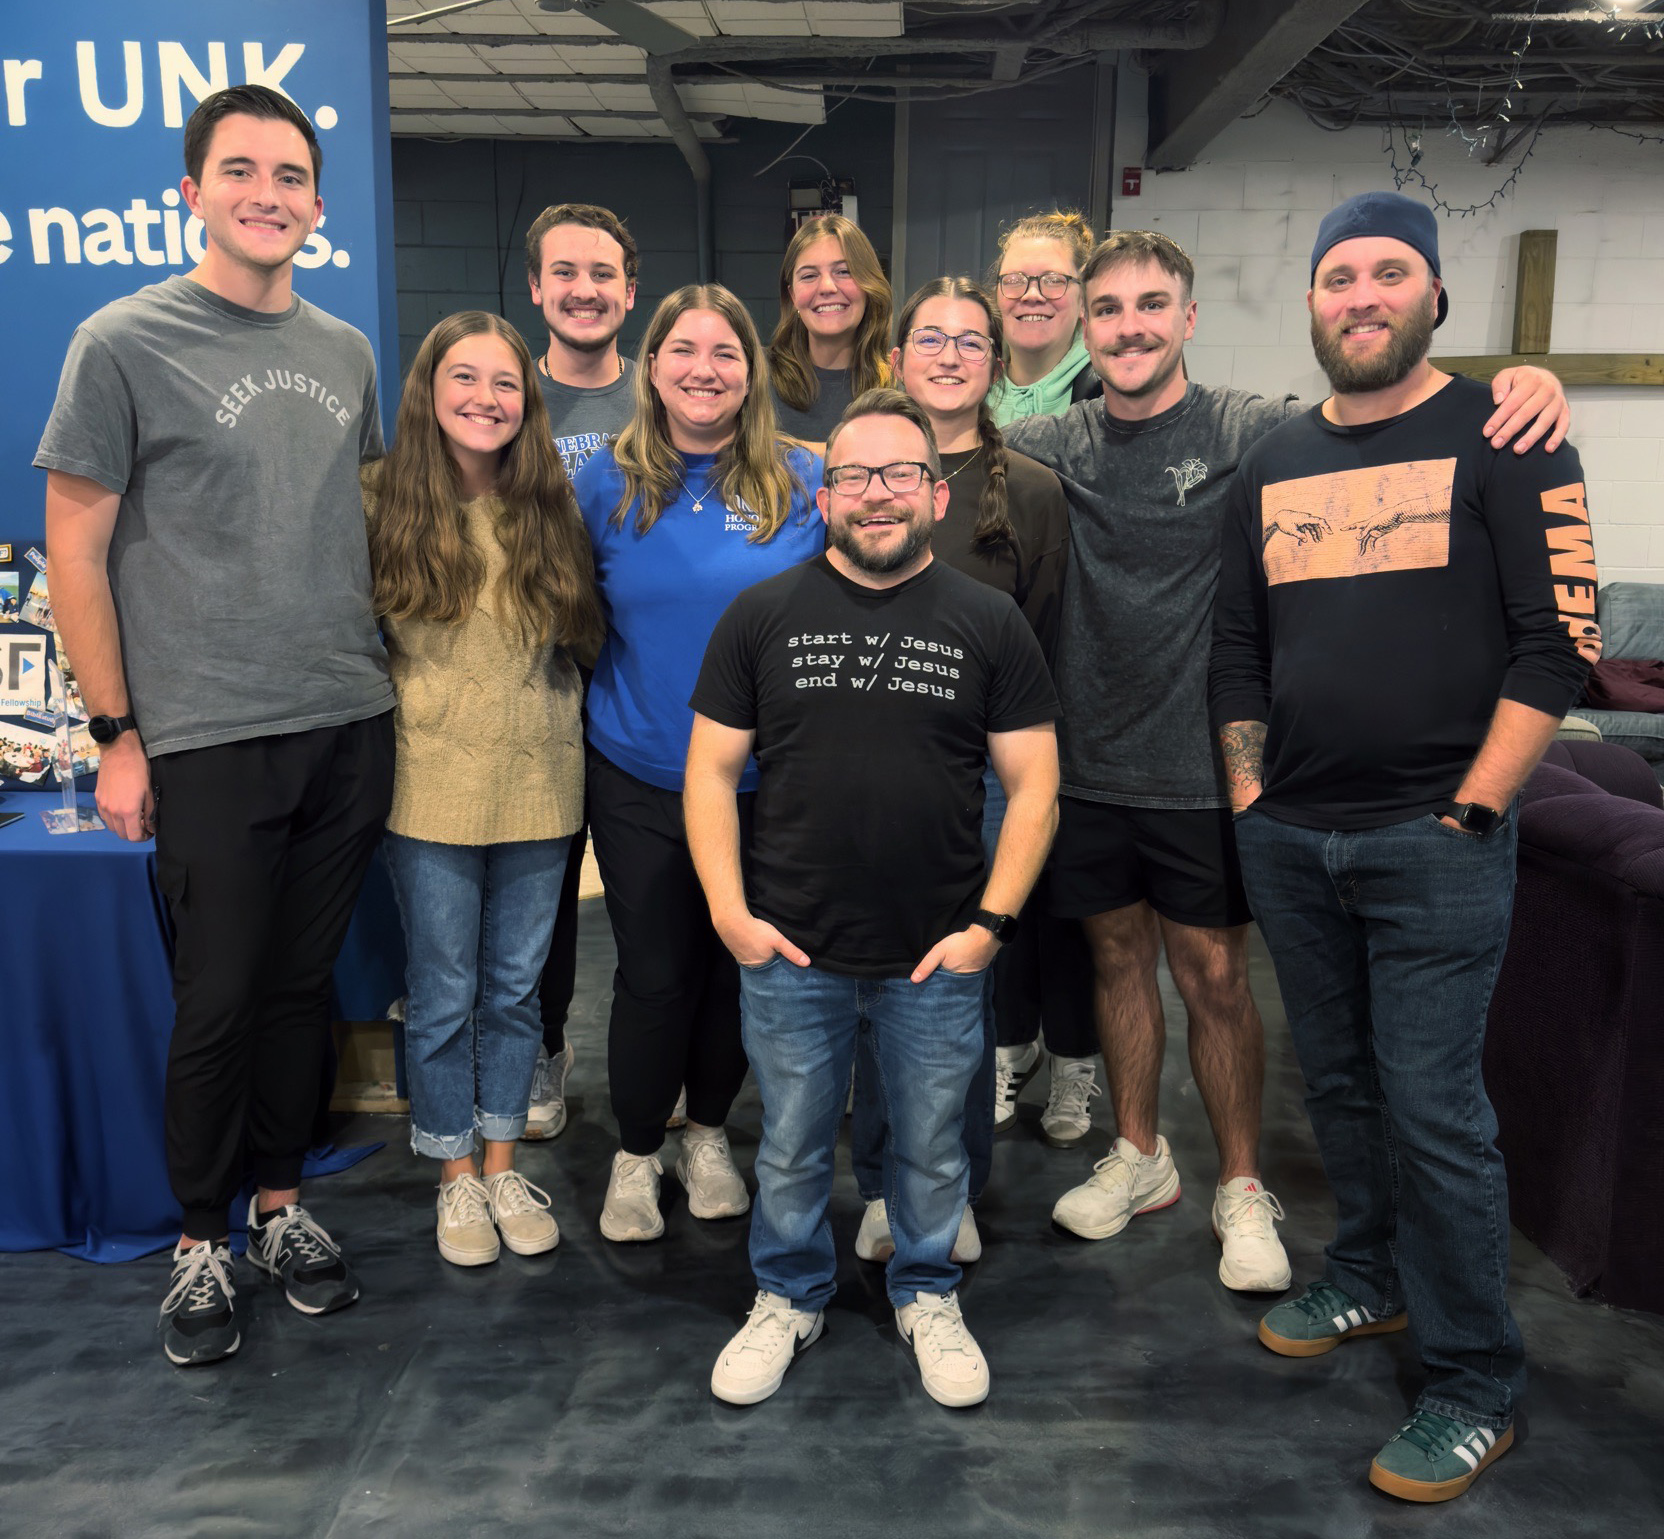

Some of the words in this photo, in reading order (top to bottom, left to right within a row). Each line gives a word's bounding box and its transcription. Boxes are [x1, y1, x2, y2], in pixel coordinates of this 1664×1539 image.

[28, 188, 350, 268] natis.
[215, 374, 263, 429] SEEK
[264, 369, 351, 427] JUSTICE
[553, 433, 620, 454] NEBRA
[788, 632, 852, 648] start
[865, 632, 890, 648] w/
[900, 636, 964, 660] Jesus
[791, 653, 845, 668] stay
[858, 653, 884, 669] w/
[894, 656, 960, 679] Jesus
[795, 673, 837, 689] end
[851, 674, 878, 691] w/
[888, 677, 956, 700] Jesus
[1, 698, 41, 707] Fellowship
